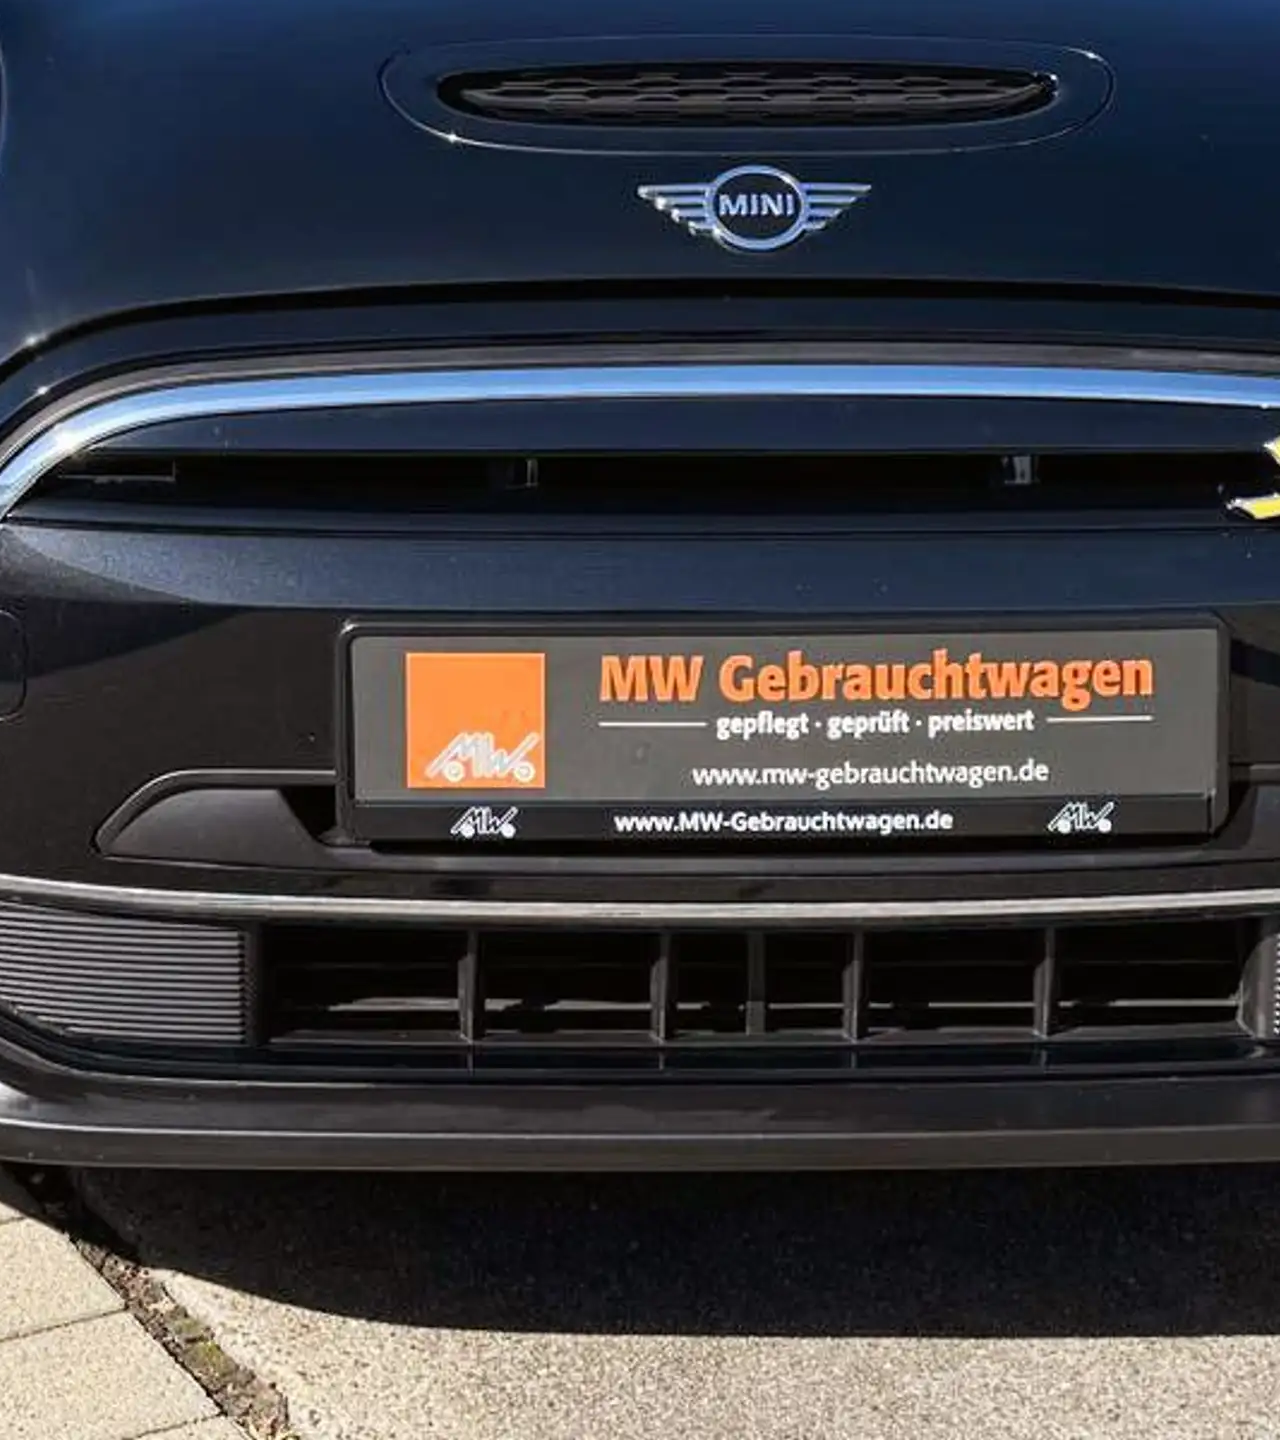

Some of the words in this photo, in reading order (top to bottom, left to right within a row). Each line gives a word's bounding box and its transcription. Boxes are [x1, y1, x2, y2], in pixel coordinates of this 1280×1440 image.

[719, 193, 796, 216] MINI
[599, 654, 704, 703] MW
[719, 648, 1154, 711] Gebrauchtwagen
[716, 711, 810, 740] gepflegt
[826, 708, 911, 740] geprüft
[928, 710, 1036, 739] preiswert
[692, 758, 1050, 791] www.mw-gebrauchtwagen.de
[613, 808, 954, 837] www.MW-Gebrauchtwagen.de
